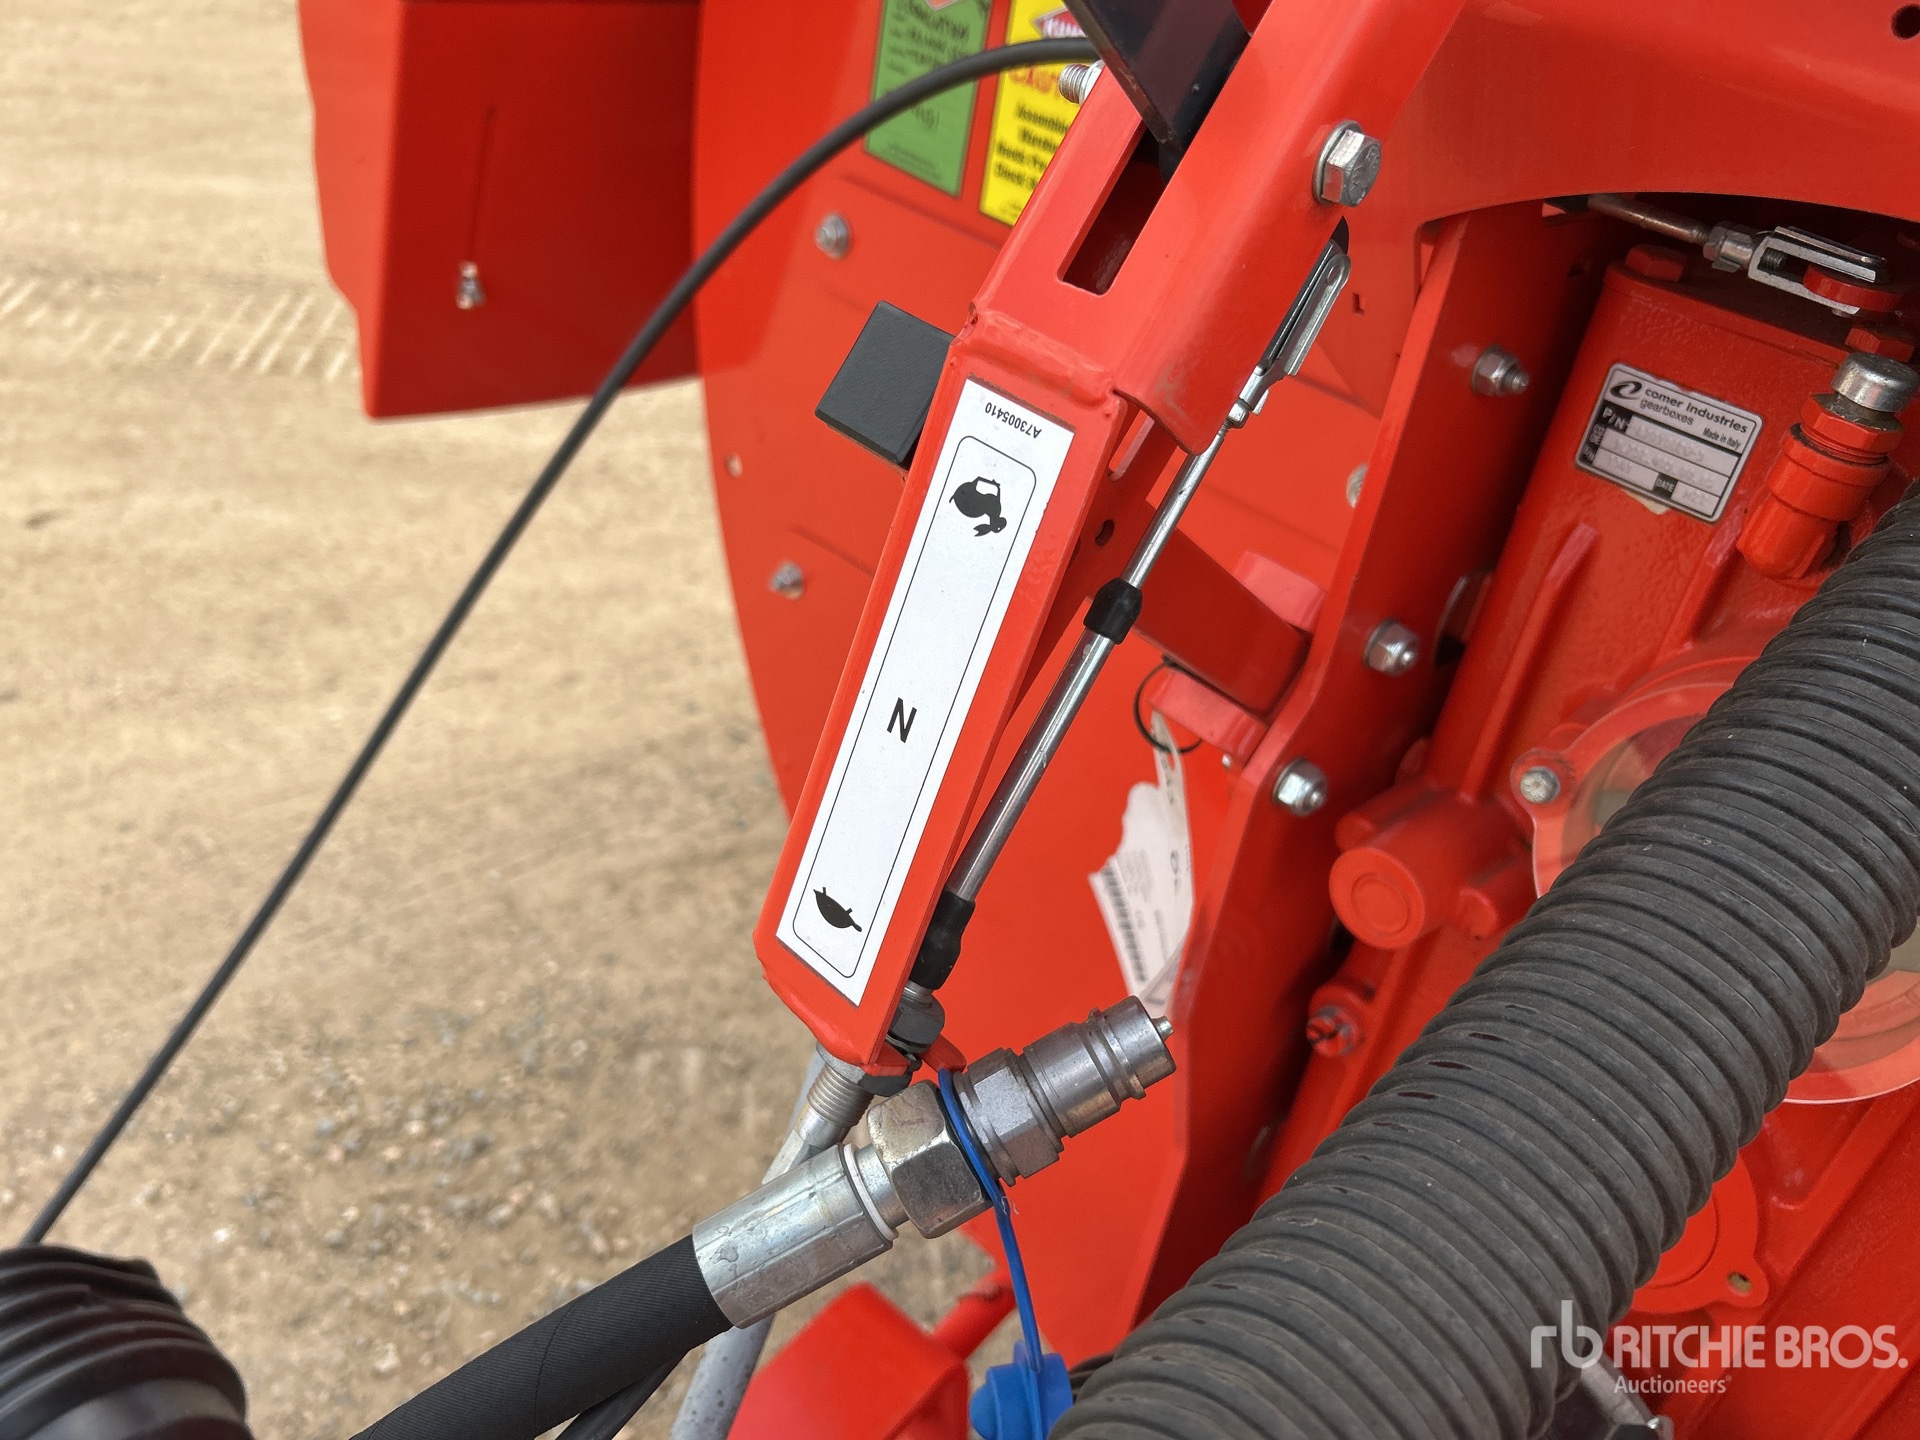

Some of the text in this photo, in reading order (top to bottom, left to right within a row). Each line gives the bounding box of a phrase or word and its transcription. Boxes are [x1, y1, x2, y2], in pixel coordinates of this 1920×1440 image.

[985, 402, 1042, 439] A73005410
[1640, 398, 1695, 425] gearboxes
[1645, 387, 1749, 434] comer industries
[1702, 427, 1720, 442] Made
[1727, 436, 1742, 451] Italy
[887, 697, 917, 743] N
